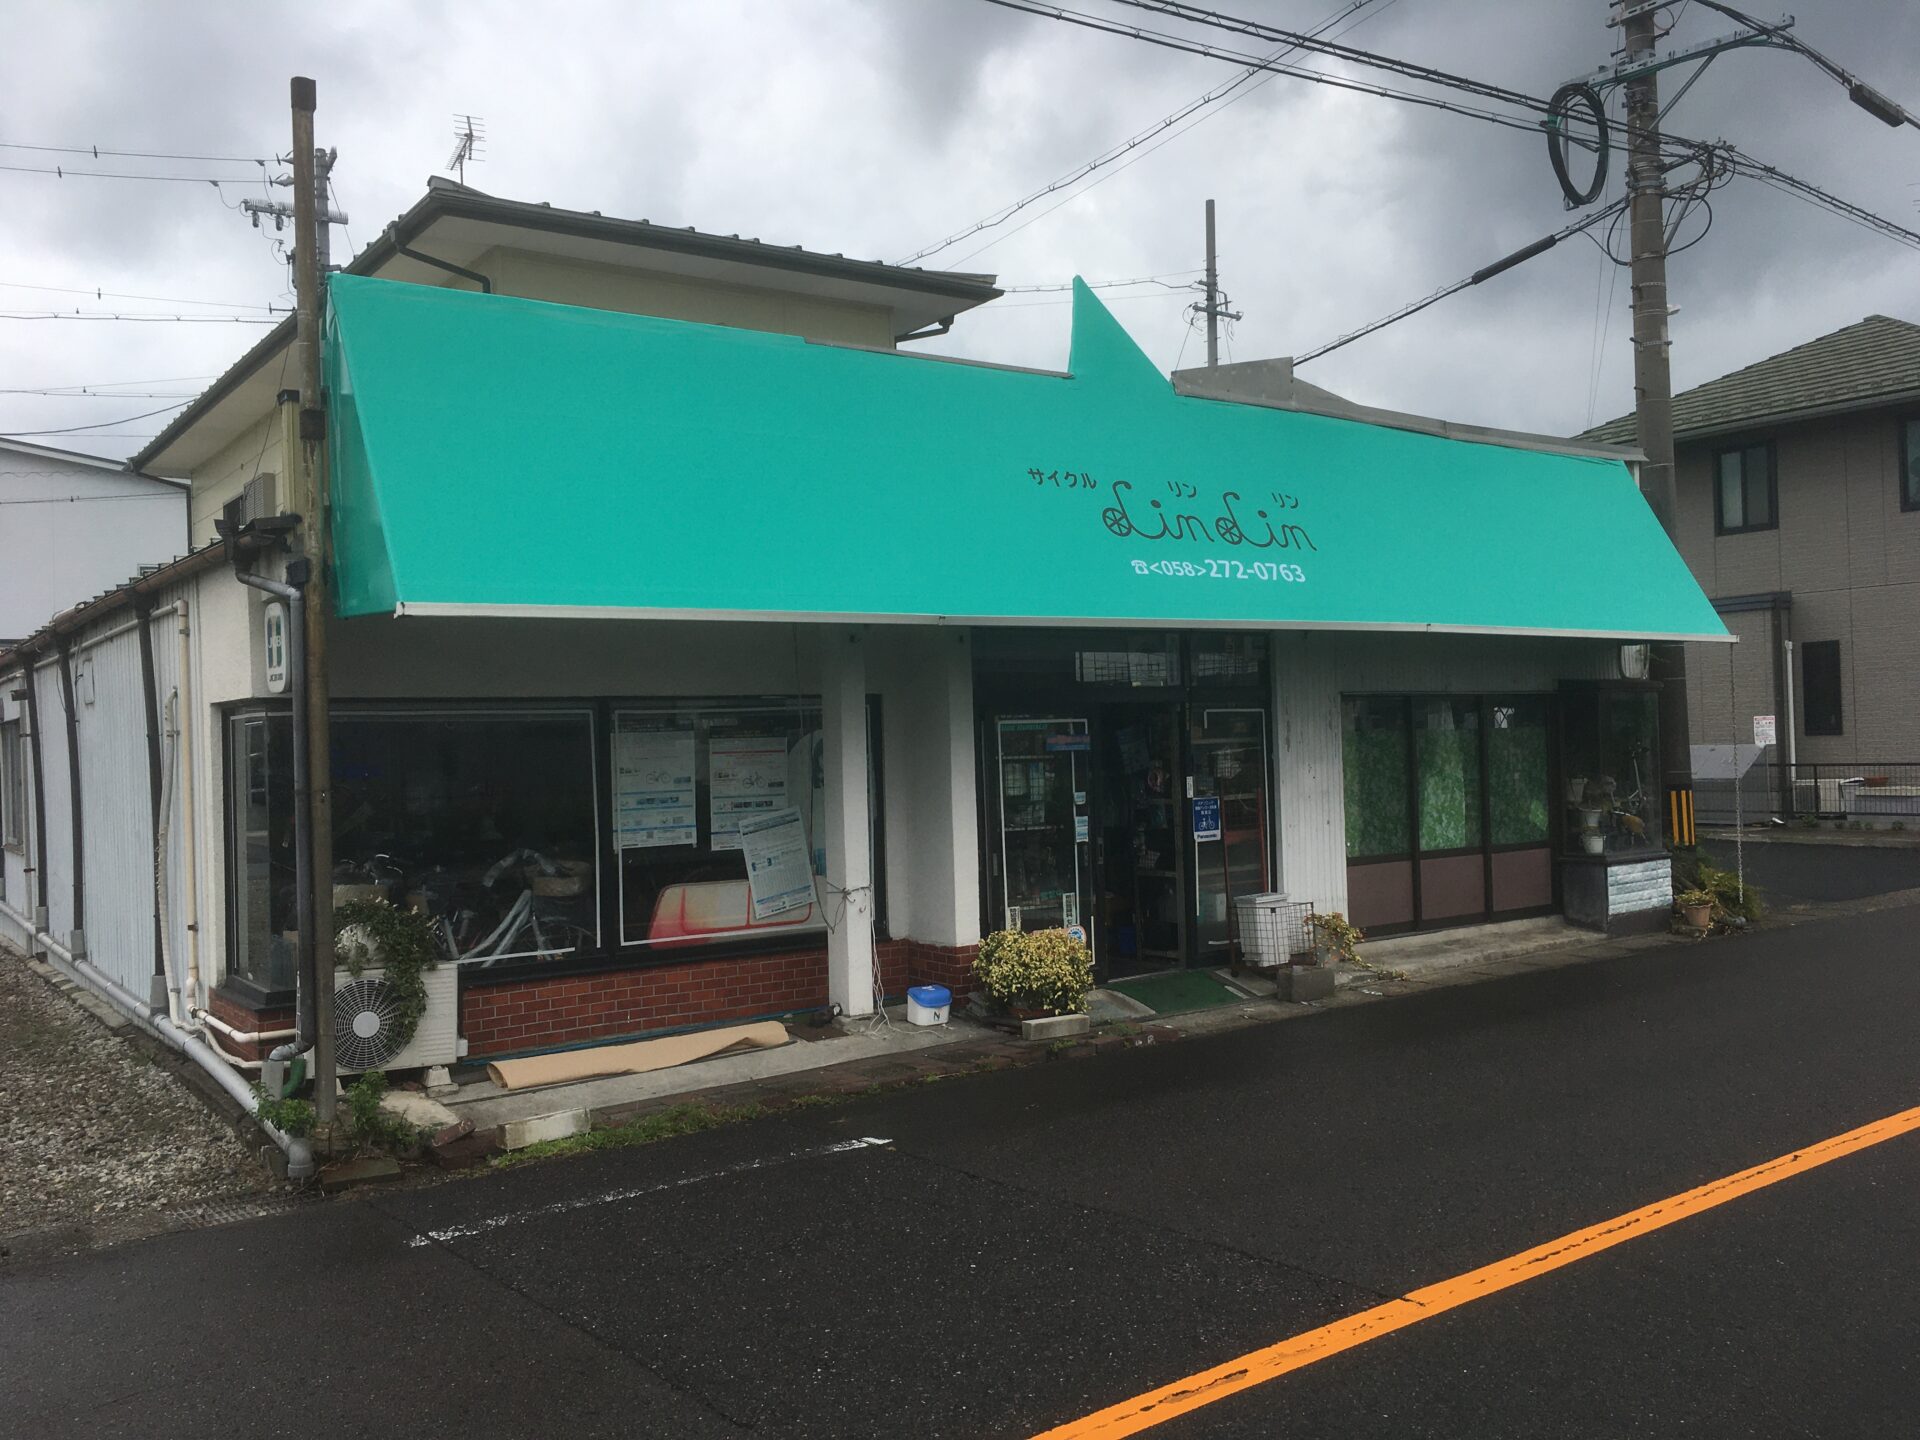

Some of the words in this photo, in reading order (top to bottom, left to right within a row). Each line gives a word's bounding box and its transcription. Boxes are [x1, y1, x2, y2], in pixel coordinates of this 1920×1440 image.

[1027, 467, 1097, 489] サイクル
[1167, 480, 1197, 498] リン
[1272, 492, 1299, 509] リン
